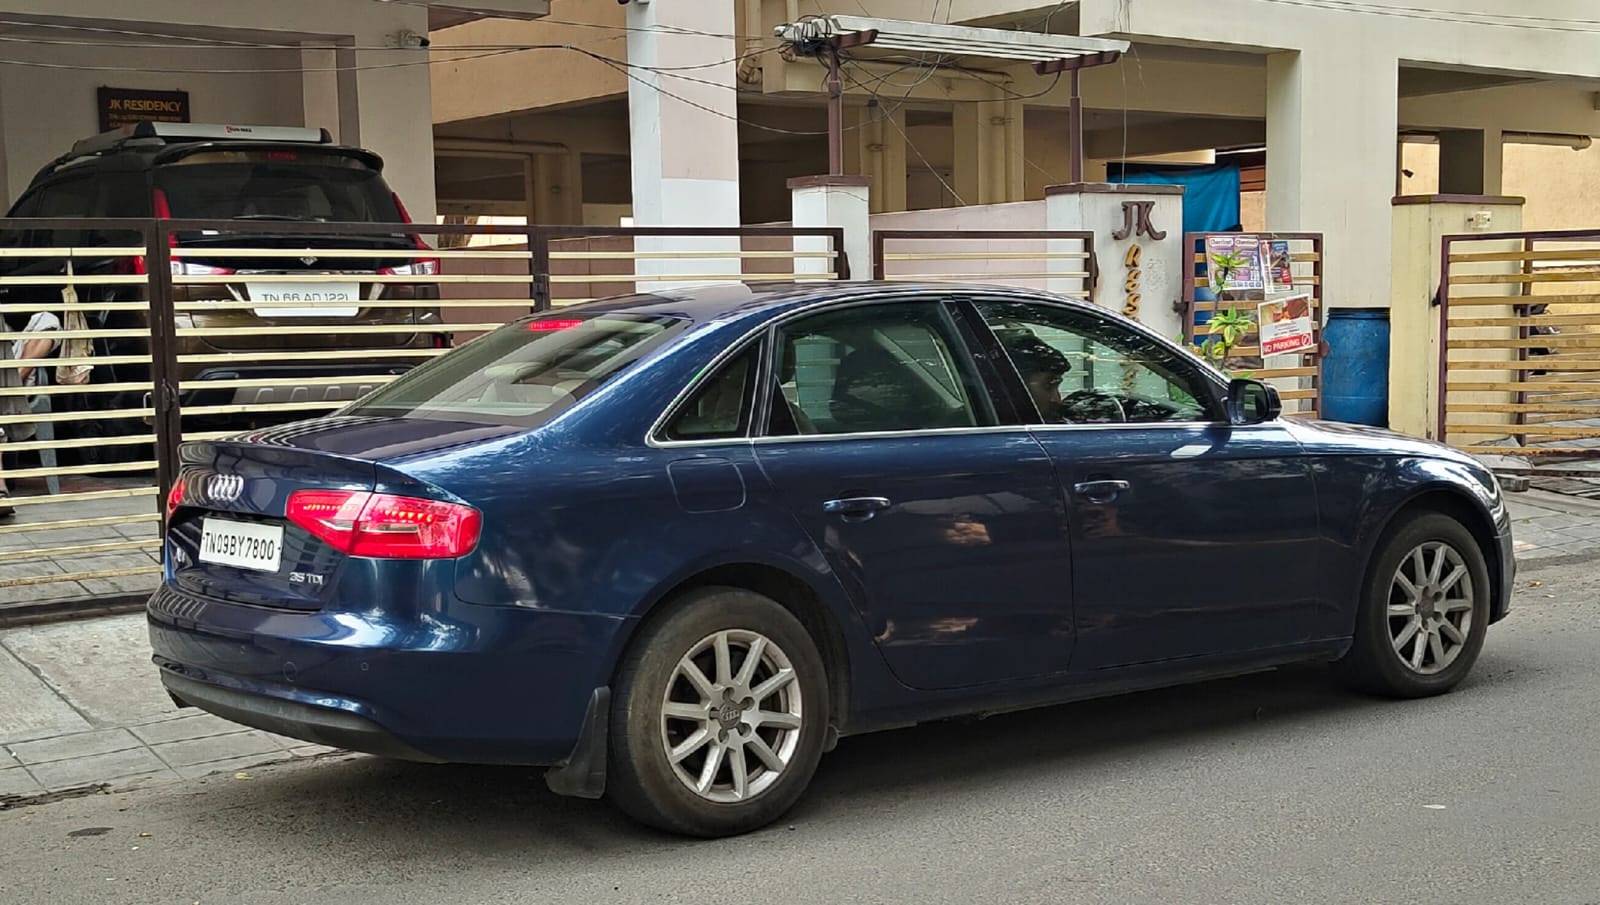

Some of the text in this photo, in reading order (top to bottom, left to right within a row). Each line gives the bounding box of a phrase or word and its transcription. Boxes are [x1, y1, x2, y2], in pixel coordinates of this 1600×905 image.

[109, 99, 182, 112] JK RESIDENCY
[1112, 201, 1167, 240] JK
[1272, 338, 1300, 351] PARKING
[204, 531, 275, 560] TN09BY7800
[289, 571, 323, 585] 35 TDI
